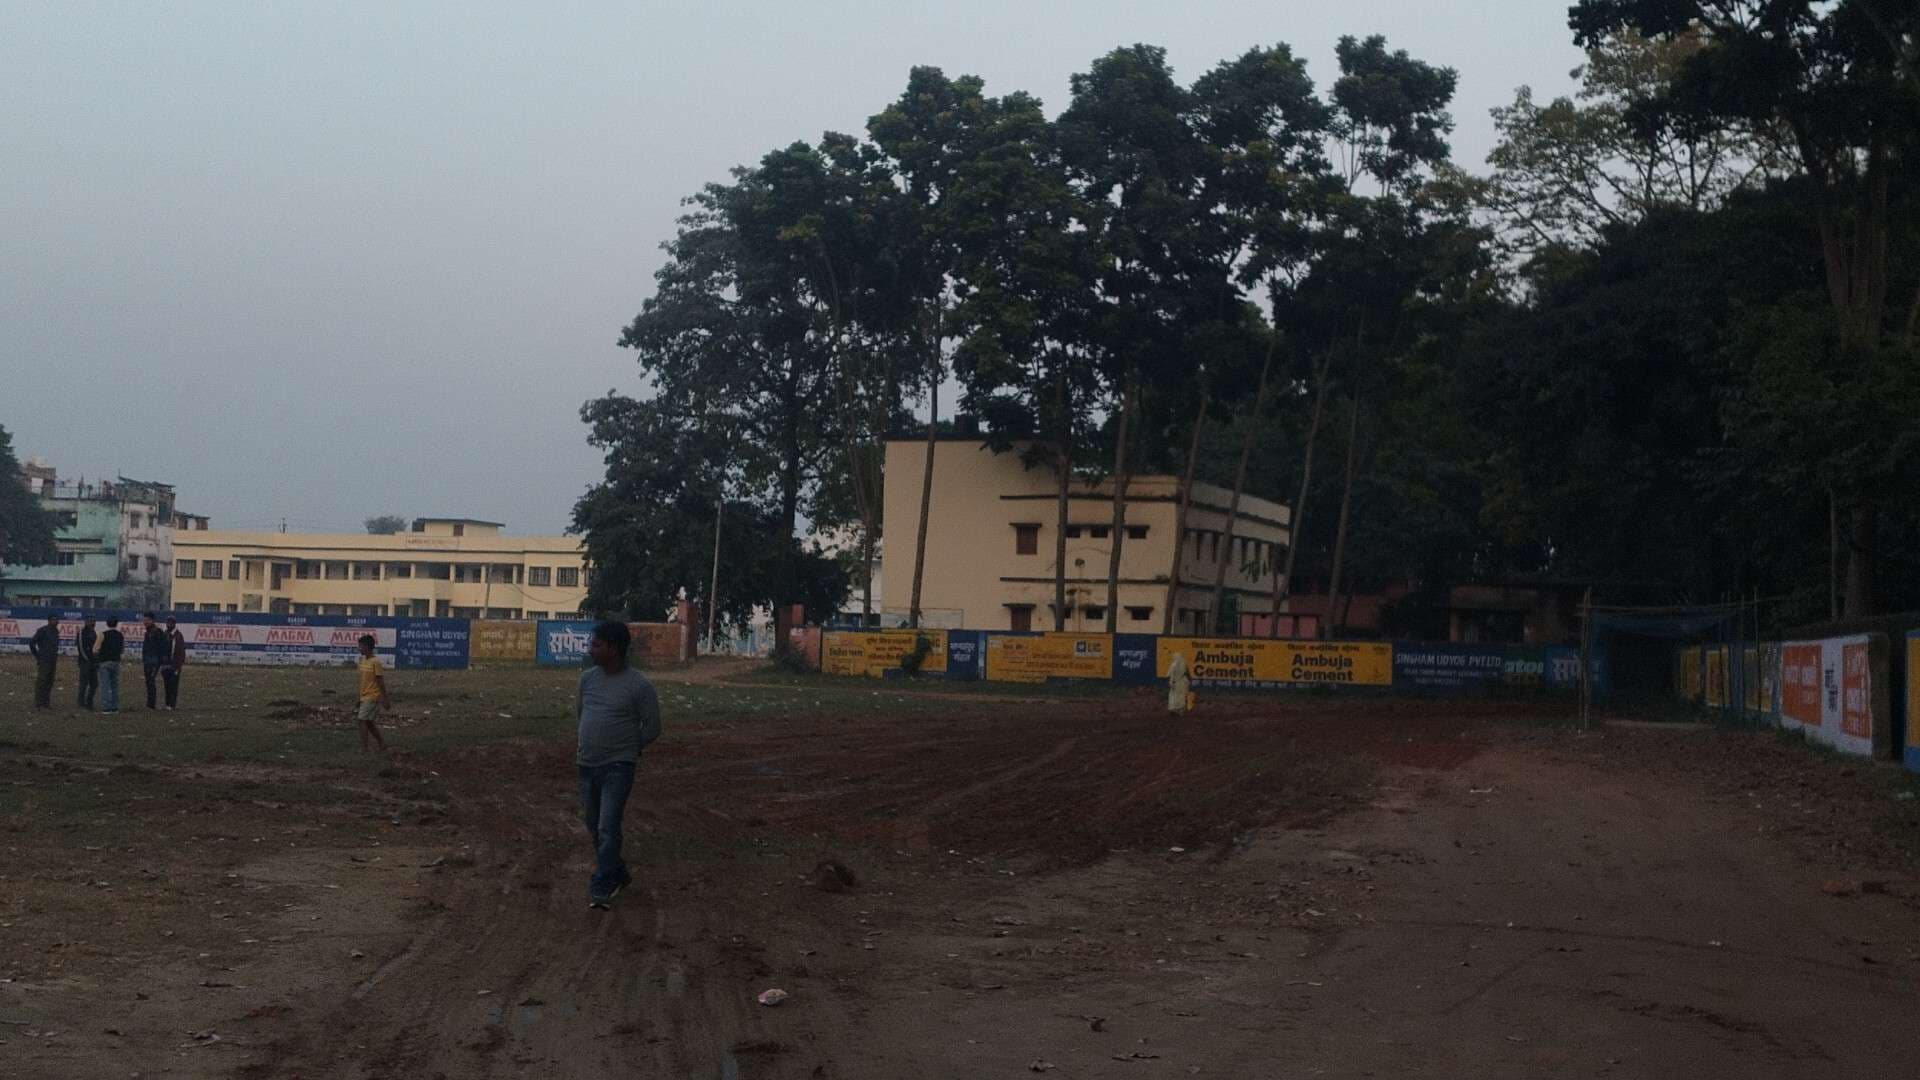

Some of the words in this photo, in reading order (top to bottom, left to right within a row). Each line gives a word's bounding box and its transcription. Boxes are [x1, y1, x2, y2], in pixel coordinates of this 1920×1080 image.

[195, 626, 242, 641] MAGNA
[267, 628, 314, 643] MAGNA
[1195, 650, 1254, 666] Ambuja
[1291, 653, 1353, 669] Ambuja
[1194, 664, 1254, 678] Cement
[1291, 667, 1353, 681] Cement
